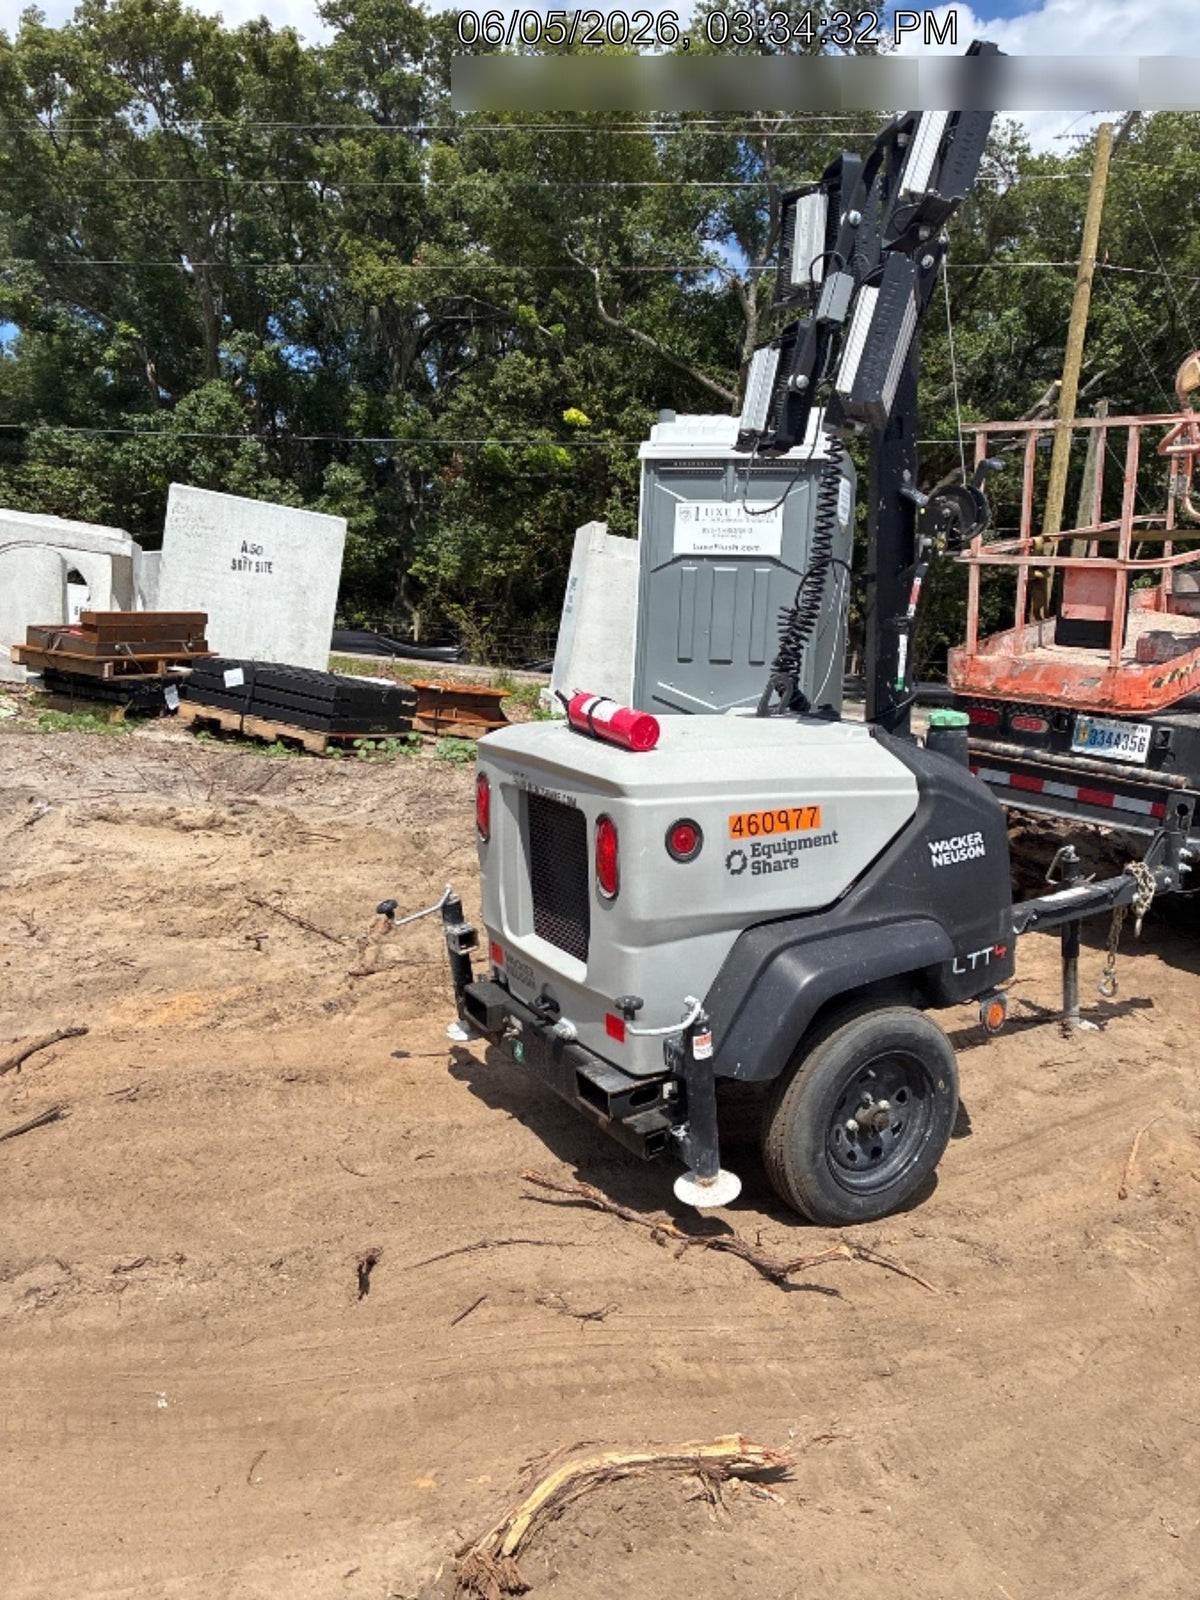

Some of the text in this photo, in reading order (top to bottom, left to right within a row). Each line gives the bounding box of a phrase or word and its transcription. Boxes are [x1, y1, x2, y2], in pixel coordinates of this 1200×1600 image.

[731, 806, 818, 837] 460977
[750, 830, 838, 858] Equipment
[928, 832, 984, 854] WACKER
[751, 857, 799, 876] Share
[931, 844, 986, 868] NEUSON
